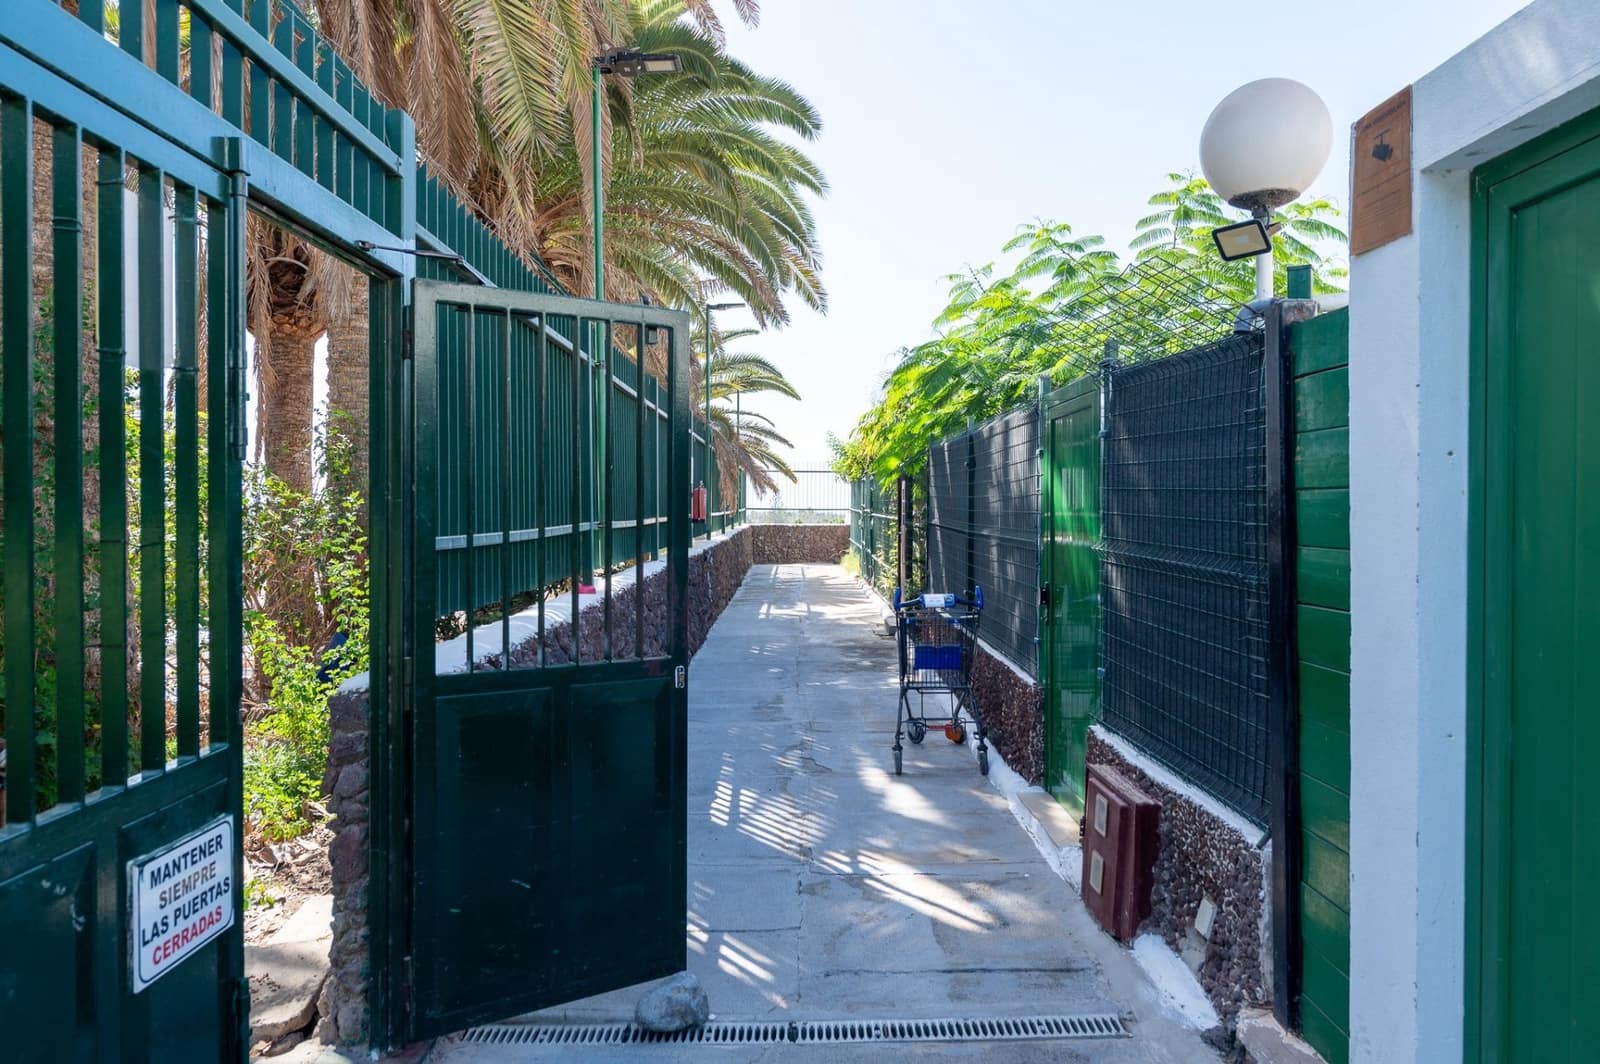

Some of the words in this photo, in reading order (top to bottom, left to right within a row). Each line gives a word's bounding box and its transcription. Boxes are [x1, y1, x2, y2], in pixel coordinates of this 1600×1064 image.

[150, 834, 223, 889] MANTENER
[159, 861, 217, 909] SIEMPRE
[142, 915, 169, 948] LAS
[174, 877, 230, 927] PUERTAS
[152, 906, 223, 966] CERRADAS
